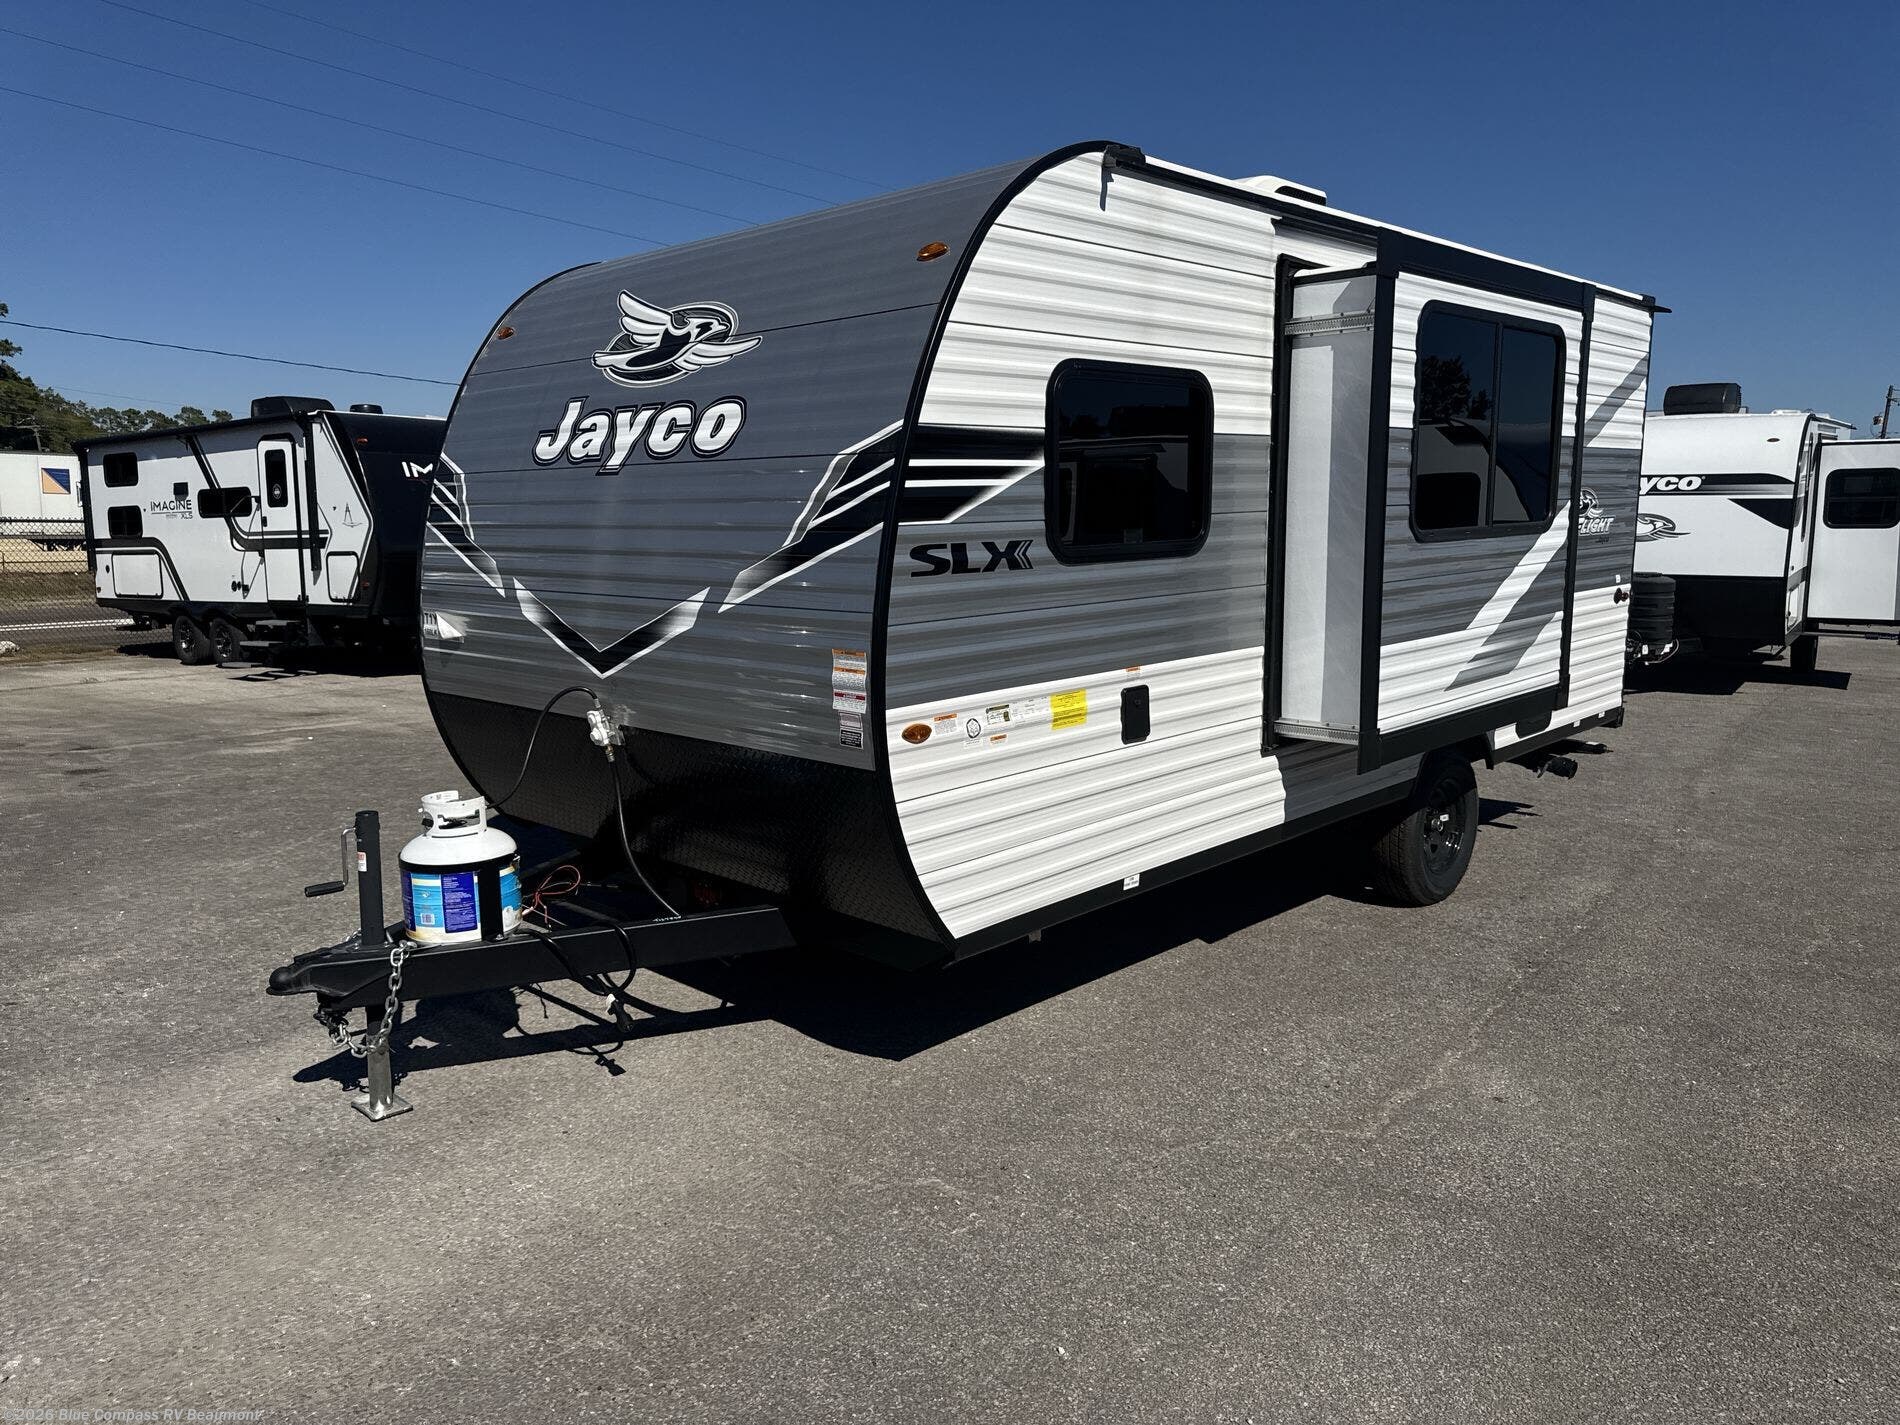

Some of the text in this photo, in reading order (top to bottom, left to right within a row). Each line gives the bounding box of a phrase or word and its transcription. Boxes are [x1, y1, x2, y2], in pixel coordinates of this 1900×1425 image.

[533, 397, 745, 473] Jayco
[150, 500, 192, 511] IMAGINE
[909, 540, 1034, 577] SLX
